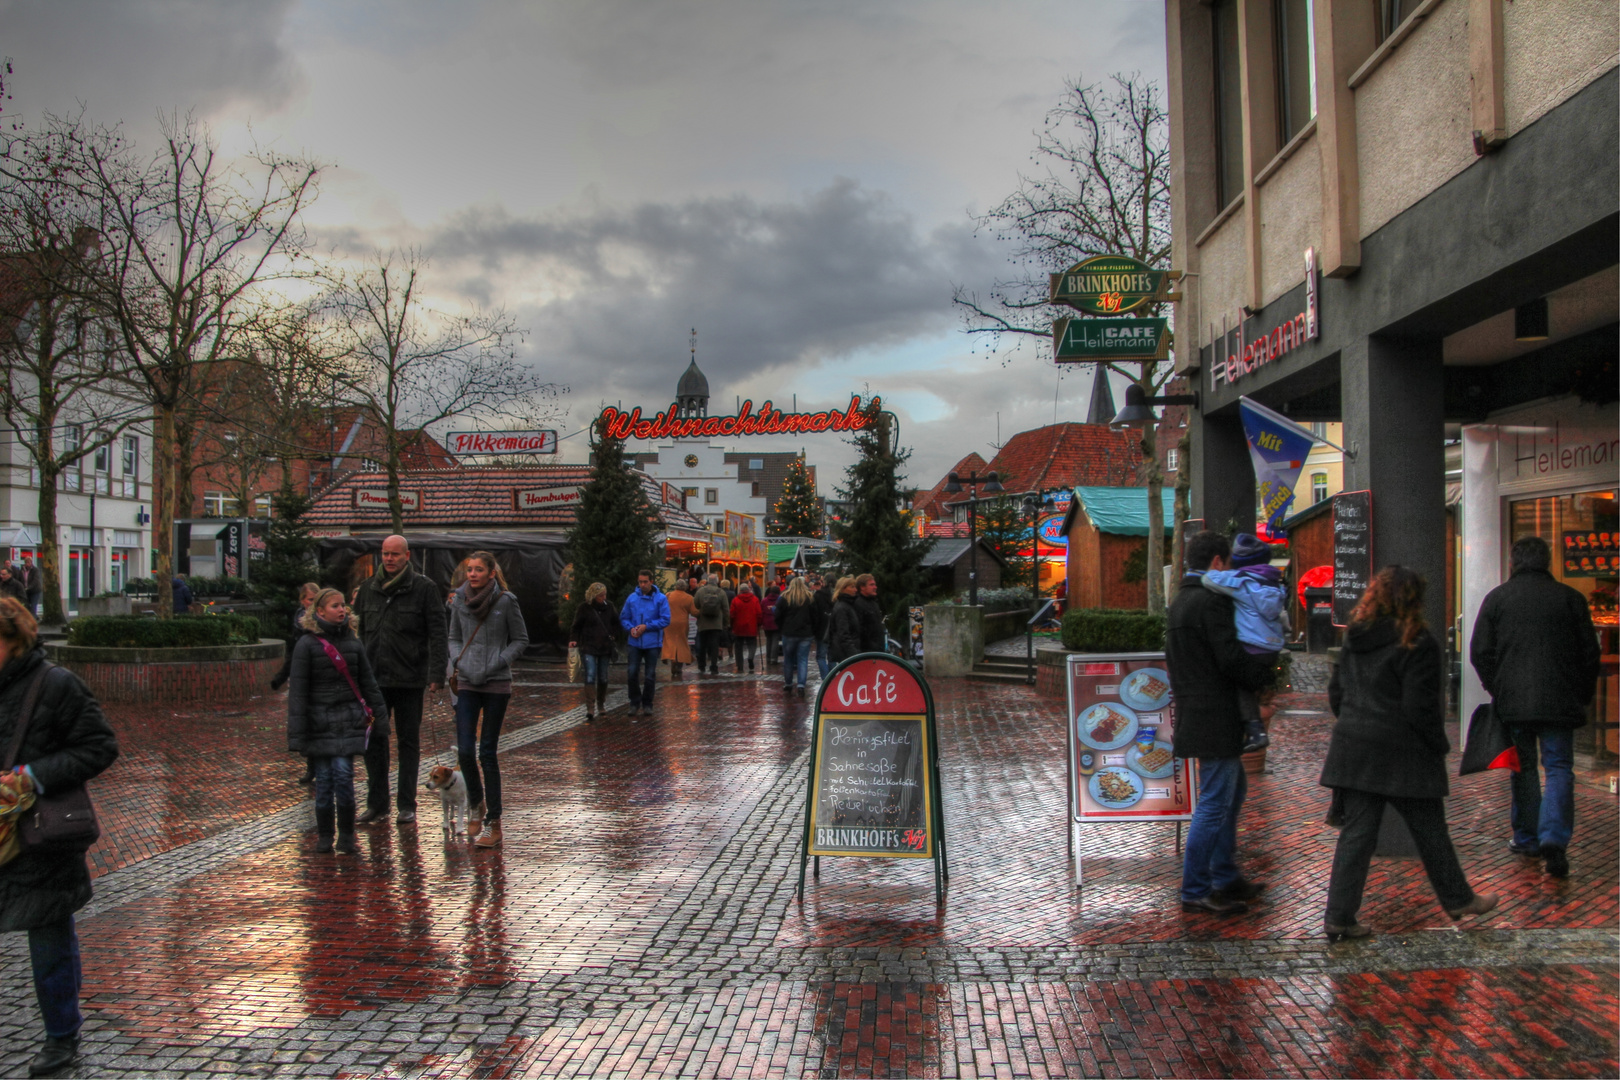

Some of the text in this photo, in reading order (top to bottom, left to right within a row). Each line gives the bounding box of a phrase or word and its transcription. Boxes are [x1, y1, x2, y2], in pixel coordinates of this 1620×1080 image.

[1068, 273, 1152, 293] BRINKHOFF's
[1069, 327, 1156, 348] Heilemann
[1105, 327, 1155, 338] CAFE
[1210, 307, 1307, 392] Heilemann
[601, 395, 881, 439] Weihnachtsmark
[456, 433, 546, 453] Pikkemaat
[1256, 431, 1283, 452] Mit
[360, 492, 389, 504] Pomm
[525, 491, 580, 505] Hamburger
[230, 526, 238, 554] zero
[1045, 527, 1061, 537] M
[837, 669, 898, 707] Café
[857, 748, 867, 758] in
[828, 757, 898, 775] Sahnesoße
[817, 828, 899, 848] BRINKHOFF's
